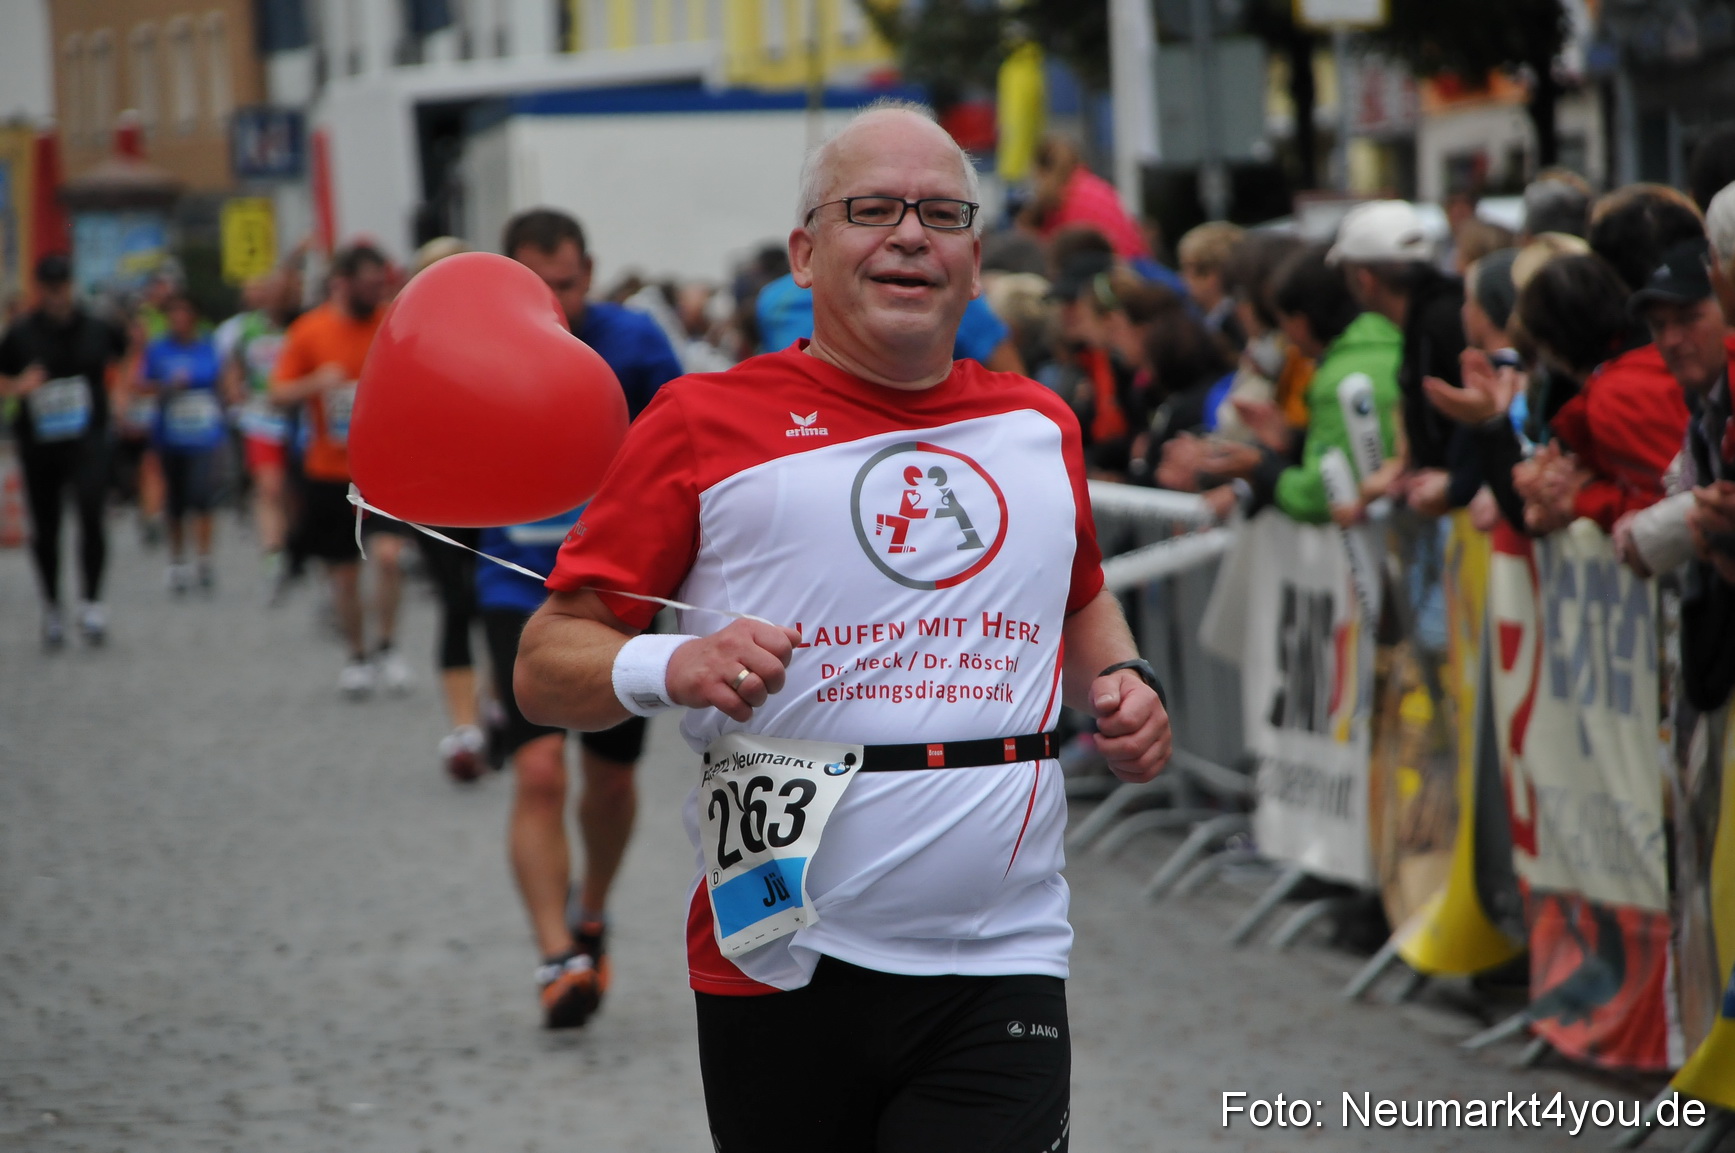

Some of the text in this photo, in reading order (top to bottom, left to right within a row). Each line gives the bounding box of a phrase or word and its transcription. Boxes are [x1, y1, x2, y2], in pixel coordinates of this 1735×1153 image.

[785, 426, 829, 437] erima
[795, 611, 1041, 649] LAUFEN MIT HERZ
[821, 663, 848, 680] Dr.
[855, 651, 903, 671] Heck
[924, 653, 952, 669] Dr.
[958, 649, 1019, 674] Röschl
[816, 680, 1014, 704] Leistungsdiagnostik
[1029, 1023, 1059, 1039] JAKO
